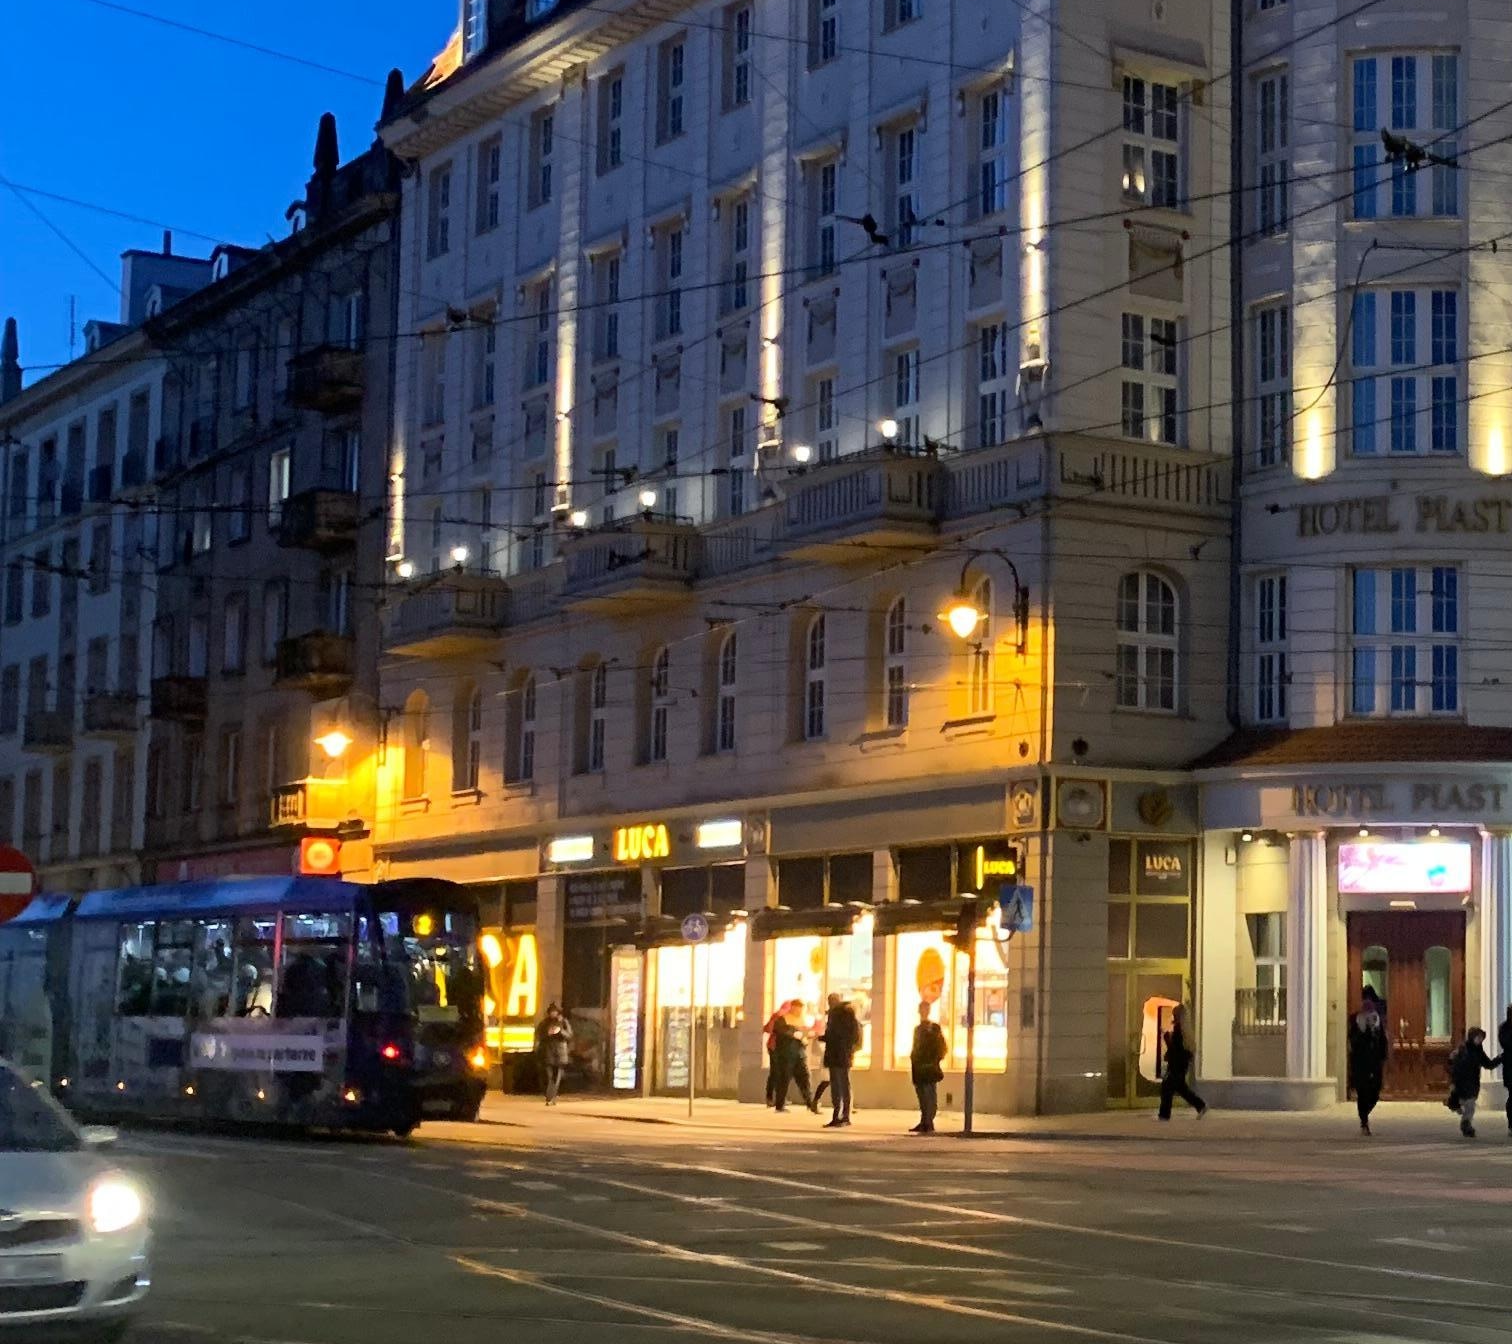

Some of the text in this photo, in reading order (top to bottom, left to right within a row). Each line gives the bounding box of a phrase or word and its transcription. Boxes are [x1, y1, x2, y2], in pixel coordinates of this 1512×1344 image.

[1296, 495, 1512, 537] HOTEL PIAST
[1291, 782, 1508, 817] HOTEL PIAST
[616, 824, 670, 862] LUCA
[984, 860, 1015, 875] LUCA
[1145, 855, 1182, 871] LUCA
